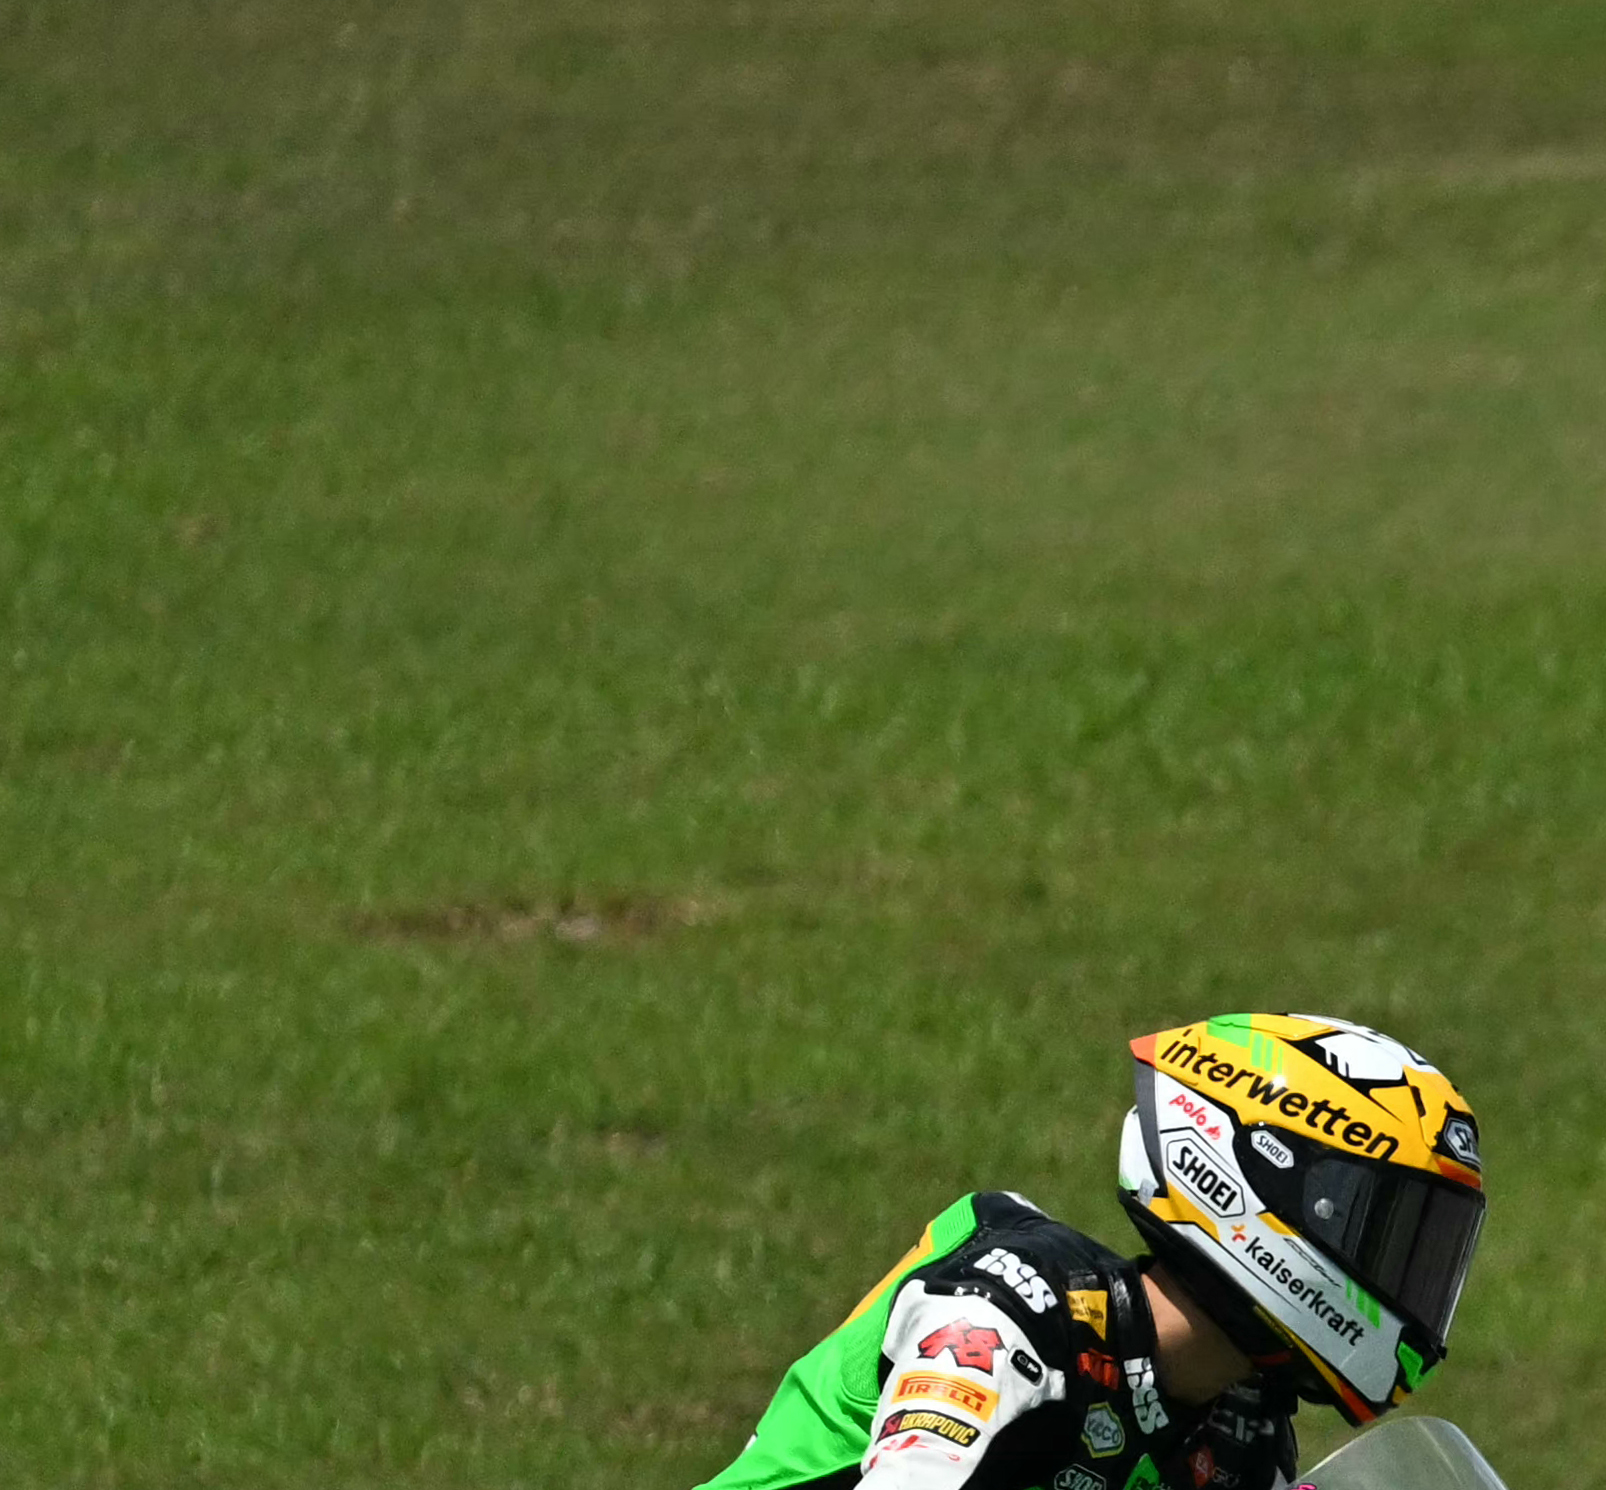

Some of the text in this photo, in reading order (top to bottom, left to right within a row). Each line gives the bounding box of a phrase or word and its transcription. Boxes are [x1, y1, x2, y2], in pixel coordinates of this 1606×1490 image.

[1161, 1028, 1399, 1161] interwetten
[1169, 1094, 1207, 1126] polo
[1256, 1133, 1288, 1164] SHOEI
[1173, 1146, 1237, 1211] SHOEI
[1245, 1236, 1364, 1346] kaiserkraft
[899, 1375, 987, 1412] PIRELLI
